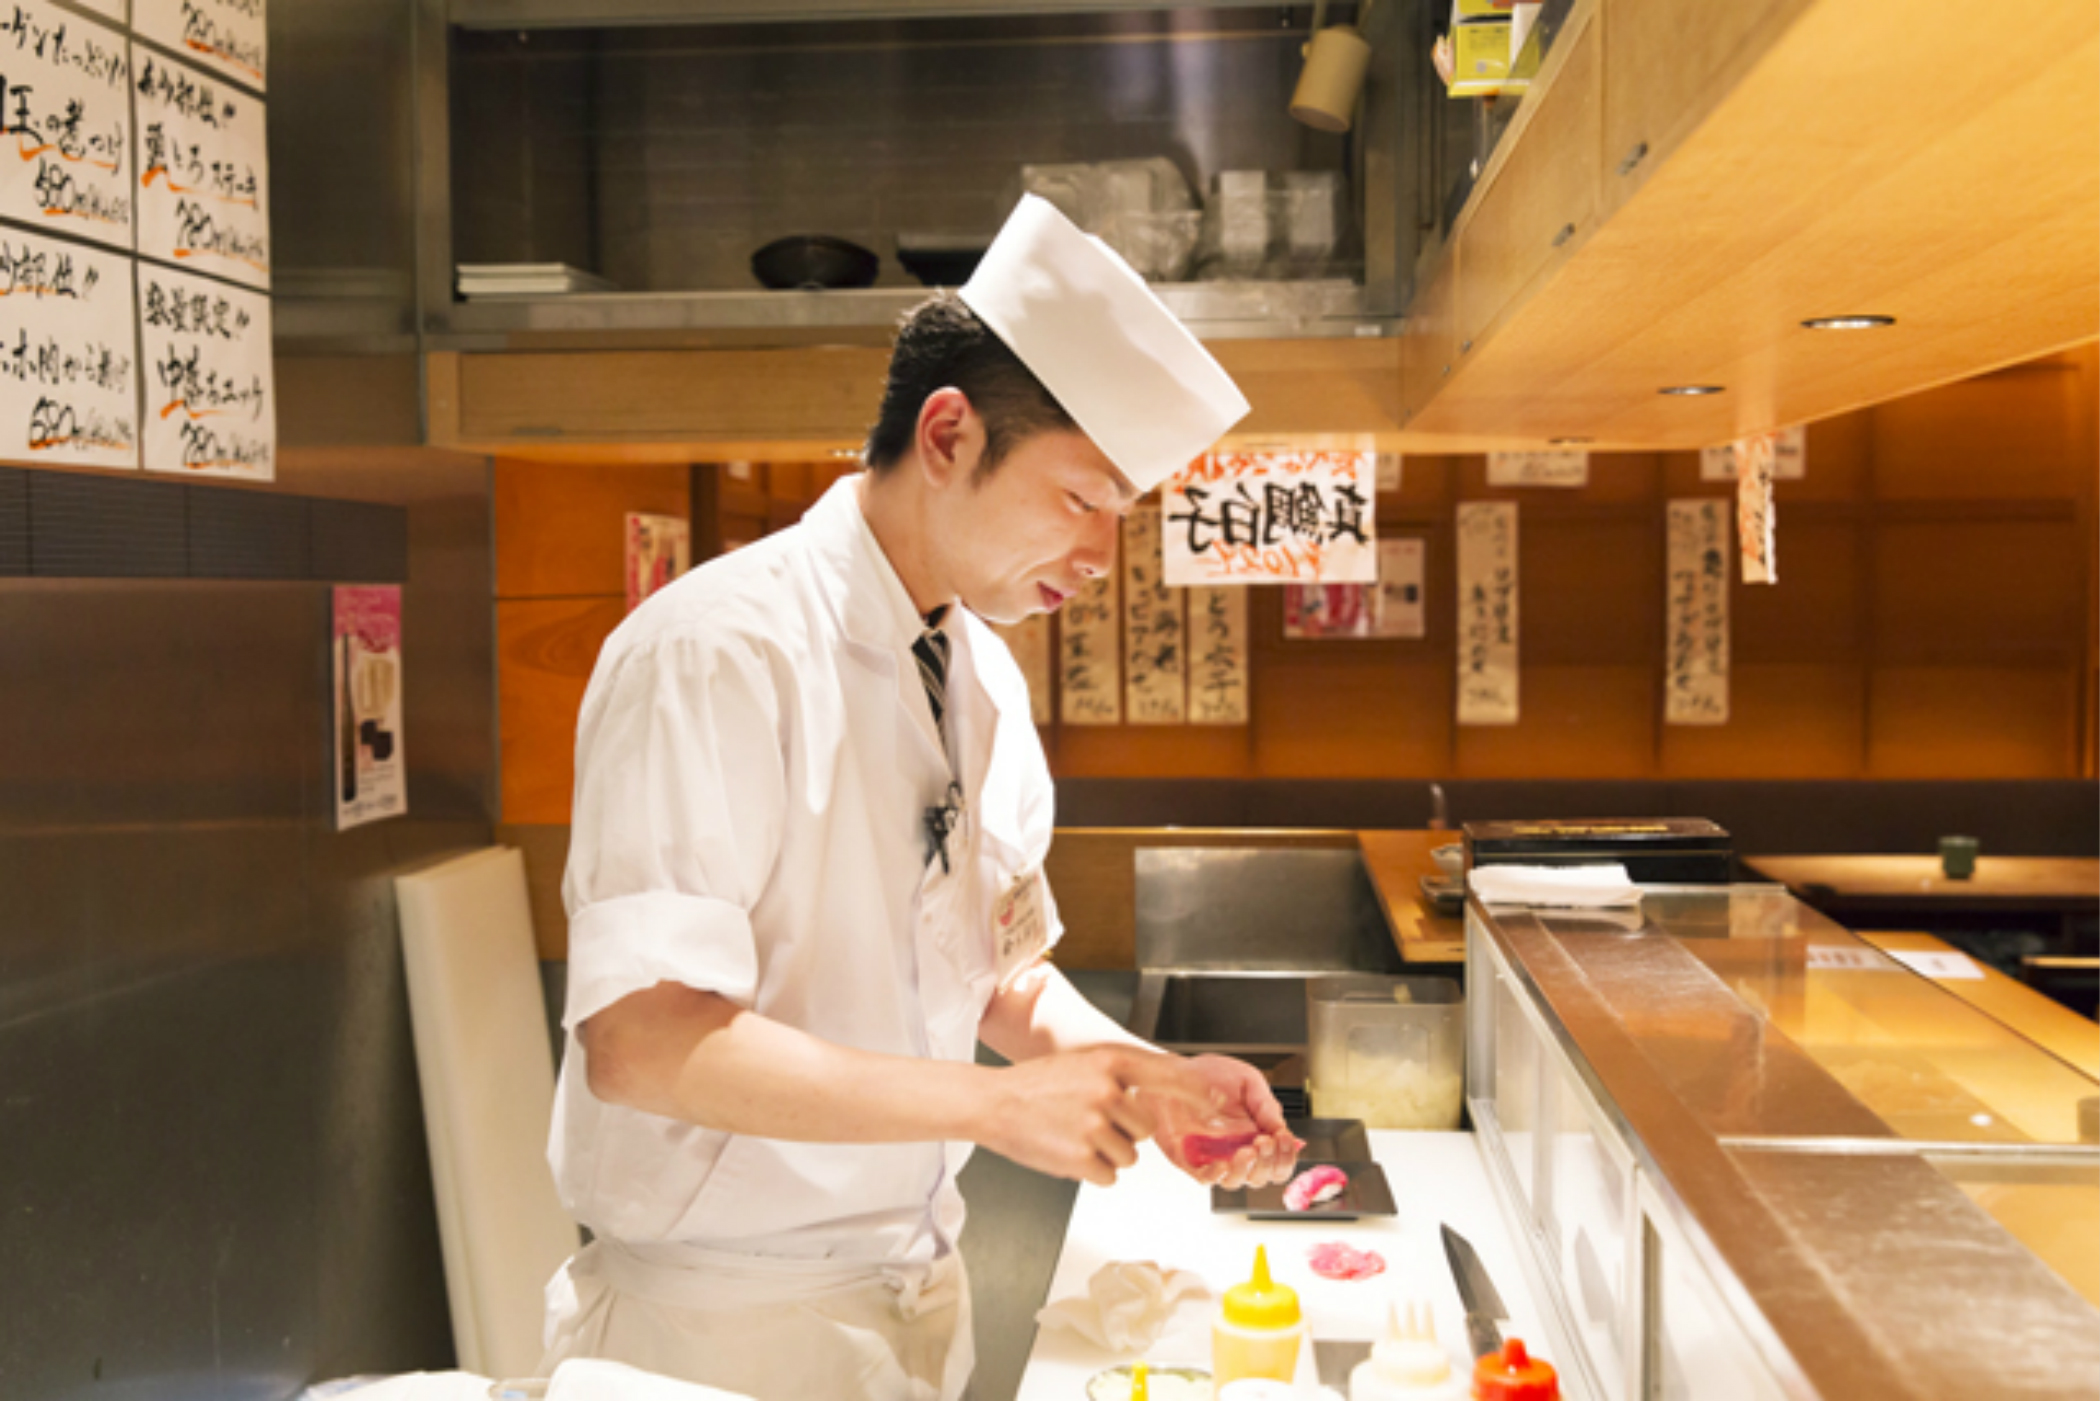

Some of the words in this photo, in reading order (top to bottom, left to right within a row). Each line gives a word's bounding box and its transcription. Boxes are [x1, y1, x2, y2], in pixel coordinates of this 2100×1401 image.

[0, 75, 123, 177] 玉の煮つけ
